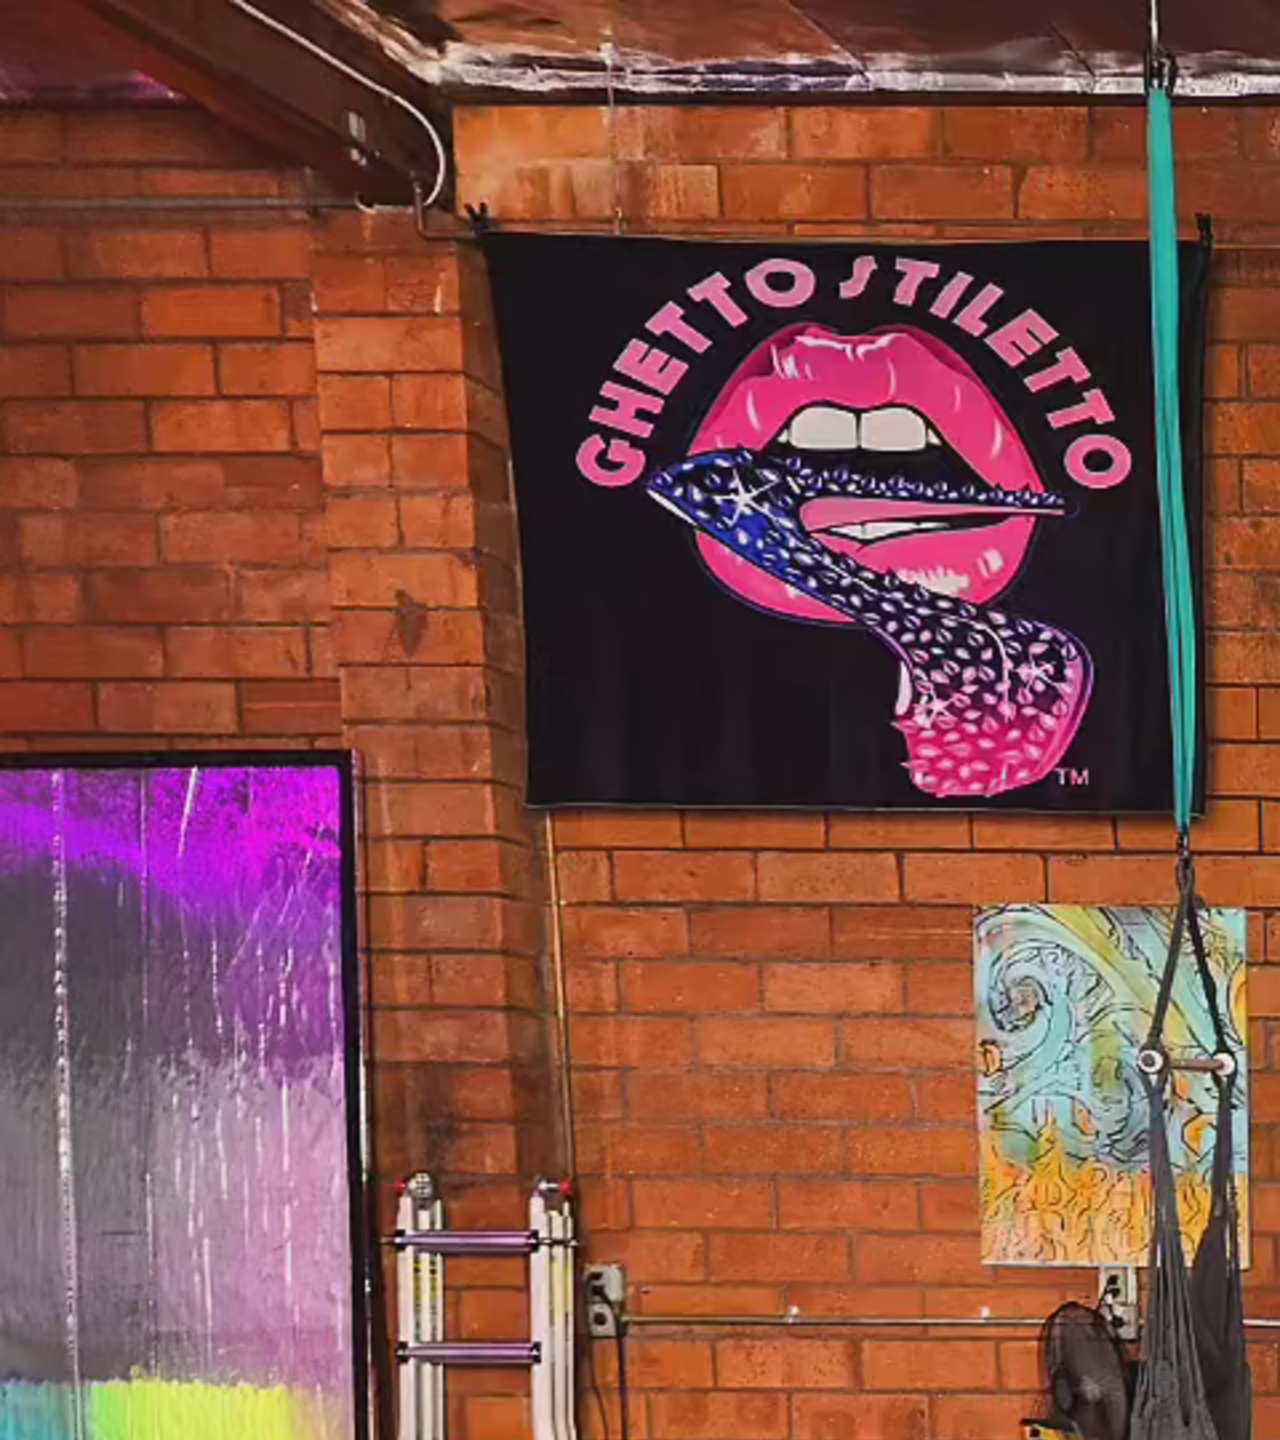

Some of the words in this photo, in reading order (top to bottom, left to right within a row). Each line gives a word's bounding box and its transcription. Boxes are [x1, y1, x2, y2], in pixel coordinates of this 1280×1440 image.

[575, 257, 816, 488] GHETTO
[838, 254, 1132, 490] STILETTO
[1054, 767, 1090, 786] TM
